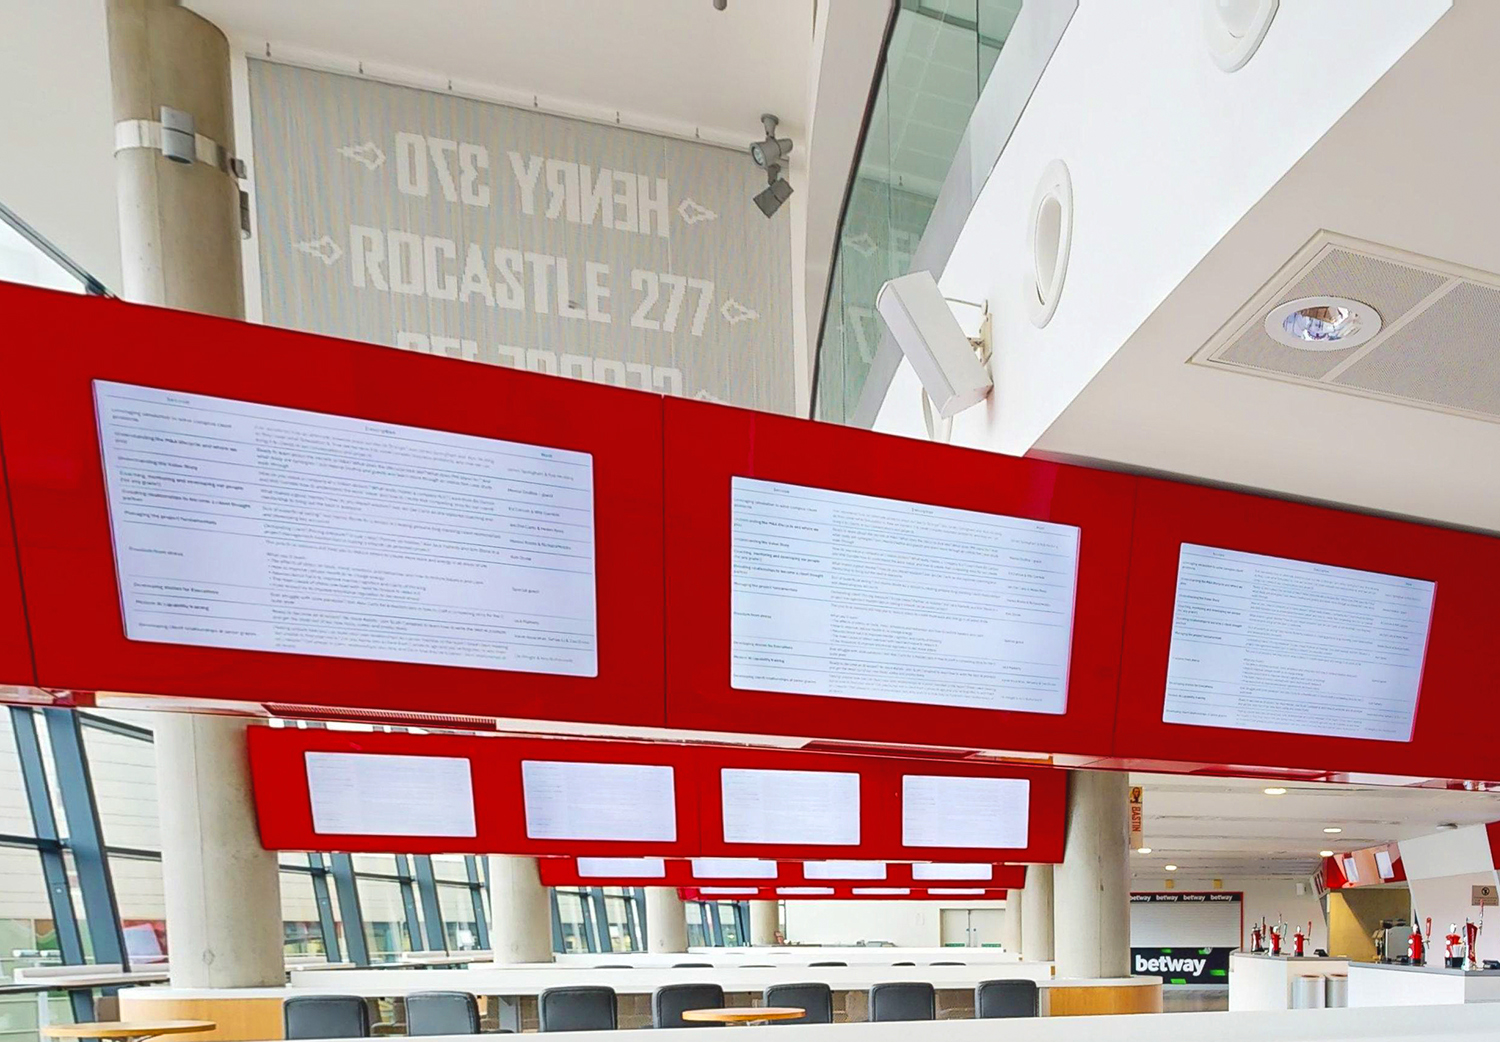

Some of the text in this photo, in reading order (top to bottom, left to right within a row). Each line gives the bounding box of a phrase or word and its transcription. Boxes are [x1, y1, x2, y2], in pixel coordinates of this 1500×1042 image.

[349, 223, 716, 337] ROCASTLE 277
[1131, 806, 1142, 832] BASTIN
[1156, 894, 1179, 902] betway
[1183, 894, 1206, 902] betway
[1210, 894, 1233, 902] betway
[1135, 954, 1206, 976] betway
